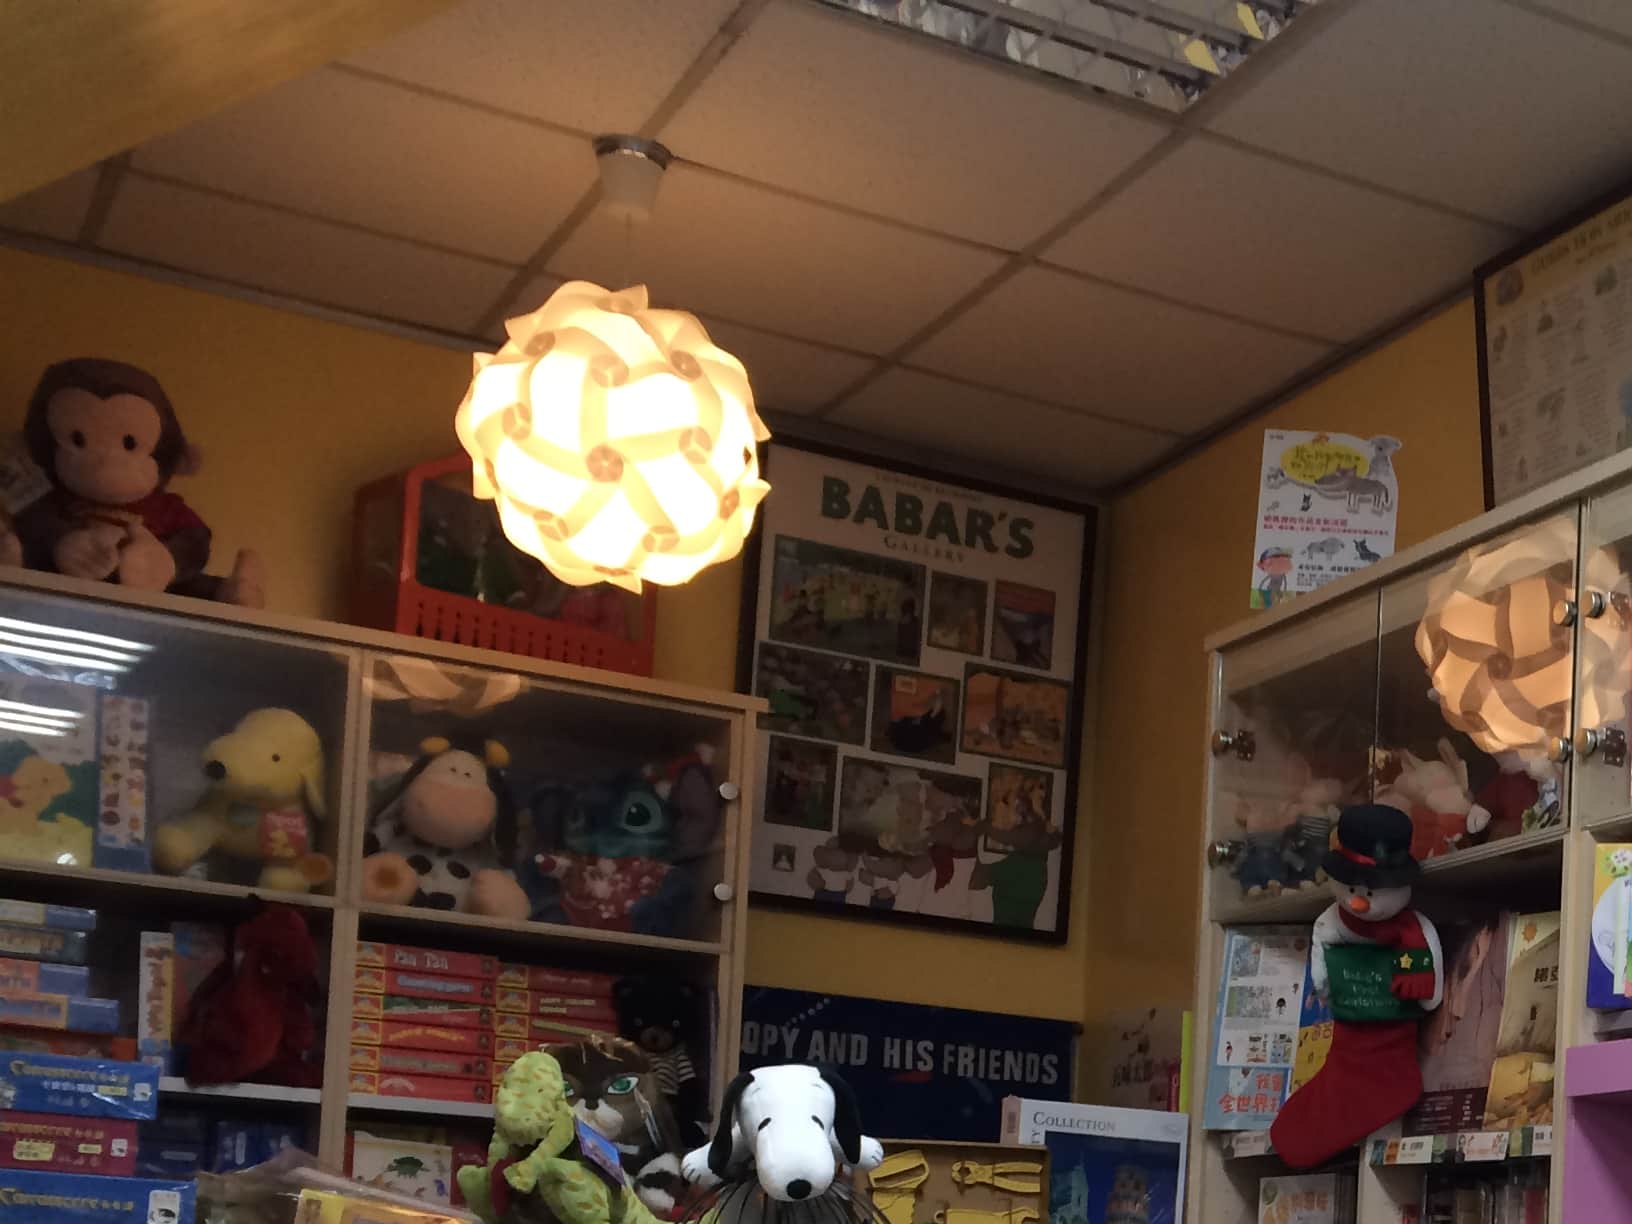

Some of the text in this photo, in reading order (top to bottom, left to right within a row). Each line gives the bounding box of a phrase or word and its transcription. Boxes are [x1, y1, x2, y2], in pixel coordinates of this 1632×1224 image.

[820, 474, 1036, 560] BABAR'S
[807, 1030, 869, 1066] AND
[883, 1036, 934, 1072] HIS
[942, 1044, 1059, 1085] FRIENDS
[1032, 1111, 1117, 1132] COLLECTION
